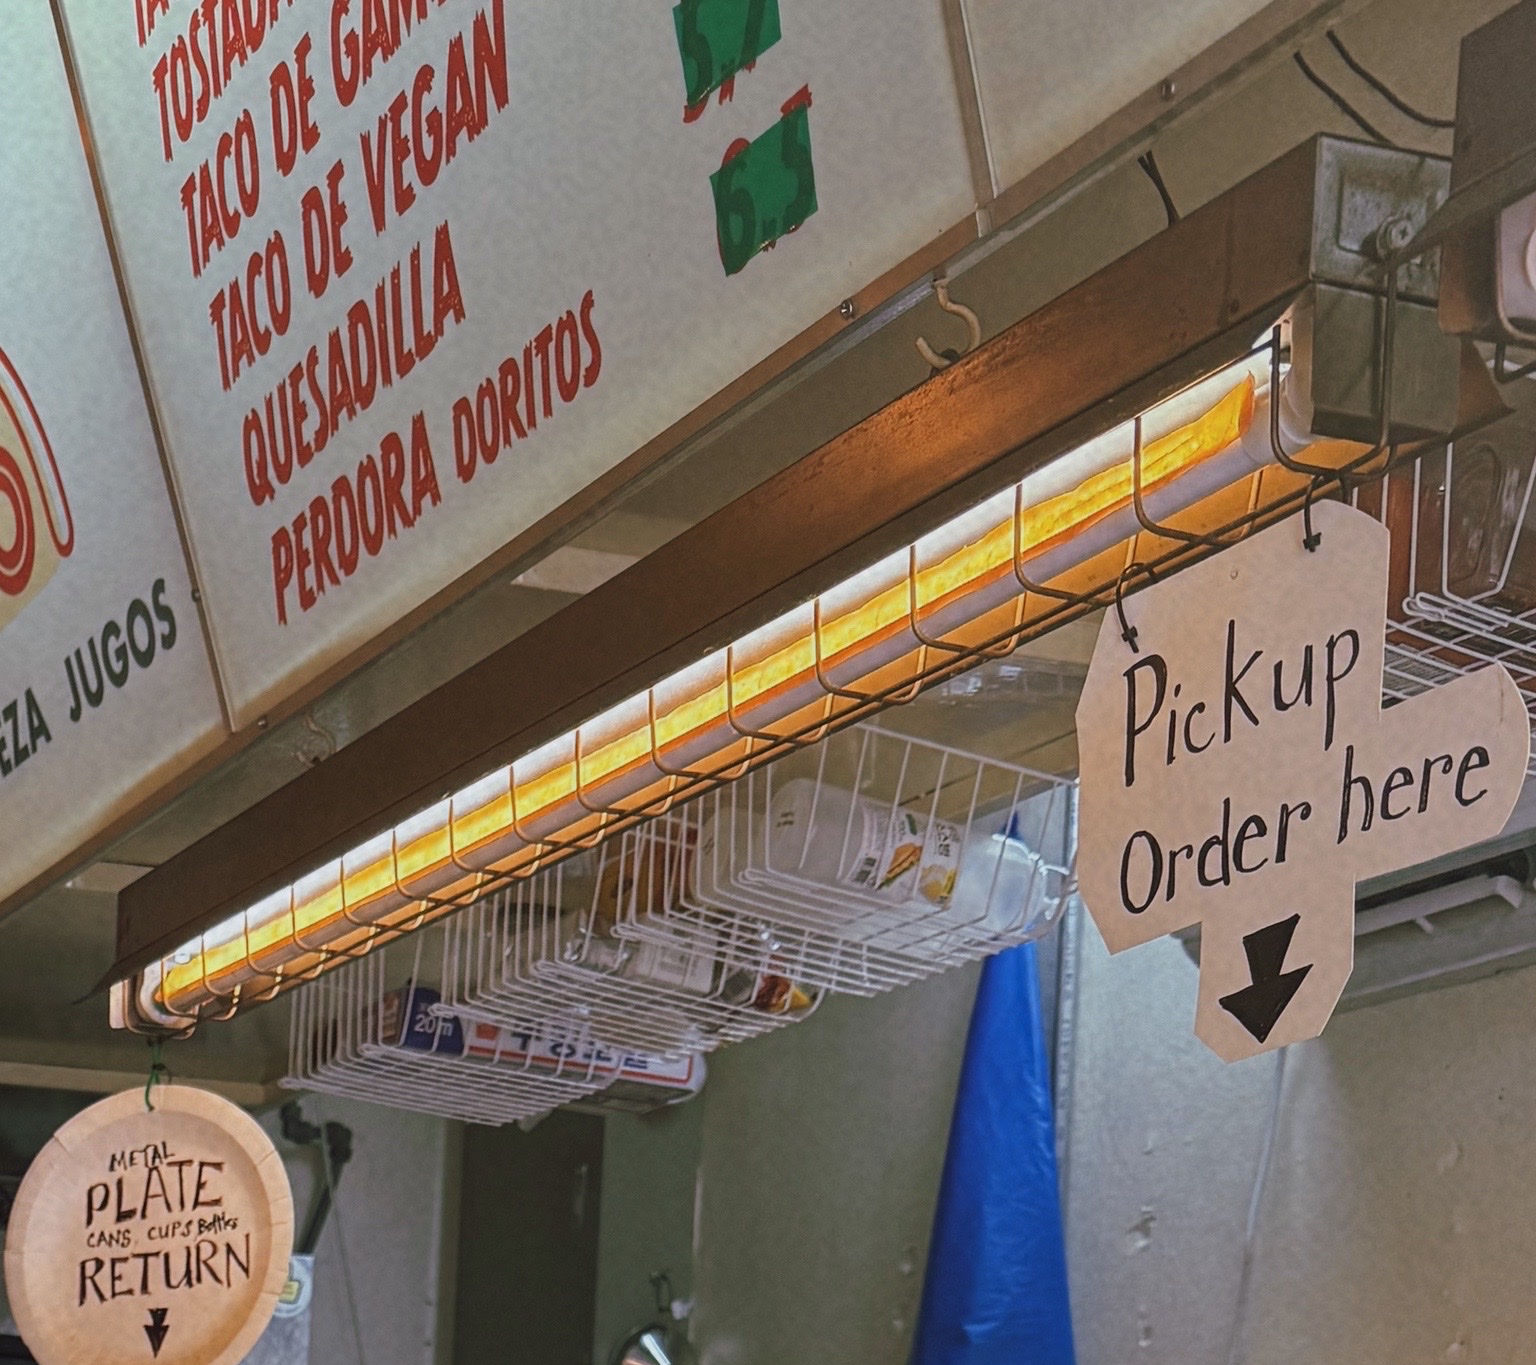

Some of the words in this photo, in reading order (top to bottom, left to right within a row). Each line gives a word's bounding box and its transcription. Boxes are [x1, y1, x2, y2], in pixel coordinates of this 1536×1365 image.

[180, 108, 260, 279] TACO
[269, 32, 322, 178] DE
[209, 230, 291, 392] TACO
[301, 158, 354, 298] DE
[359, 0, 510, 237] VEGAN
[241, 219, 466, 507] QUESADILLA
[271, 410, 442, 627] PERDORA
[452, 289, 603, 484] DORITOS
[62, 577, 178, 723] JUGOS
[1118, 797, 1312, 915] Order
[1337, 744, 1491, 845] here
[84, 1159, 226, 1229] PLATE
[108, 1140, 176, 1173] METAL
[77, 1232, 252, 1307] RETURN
